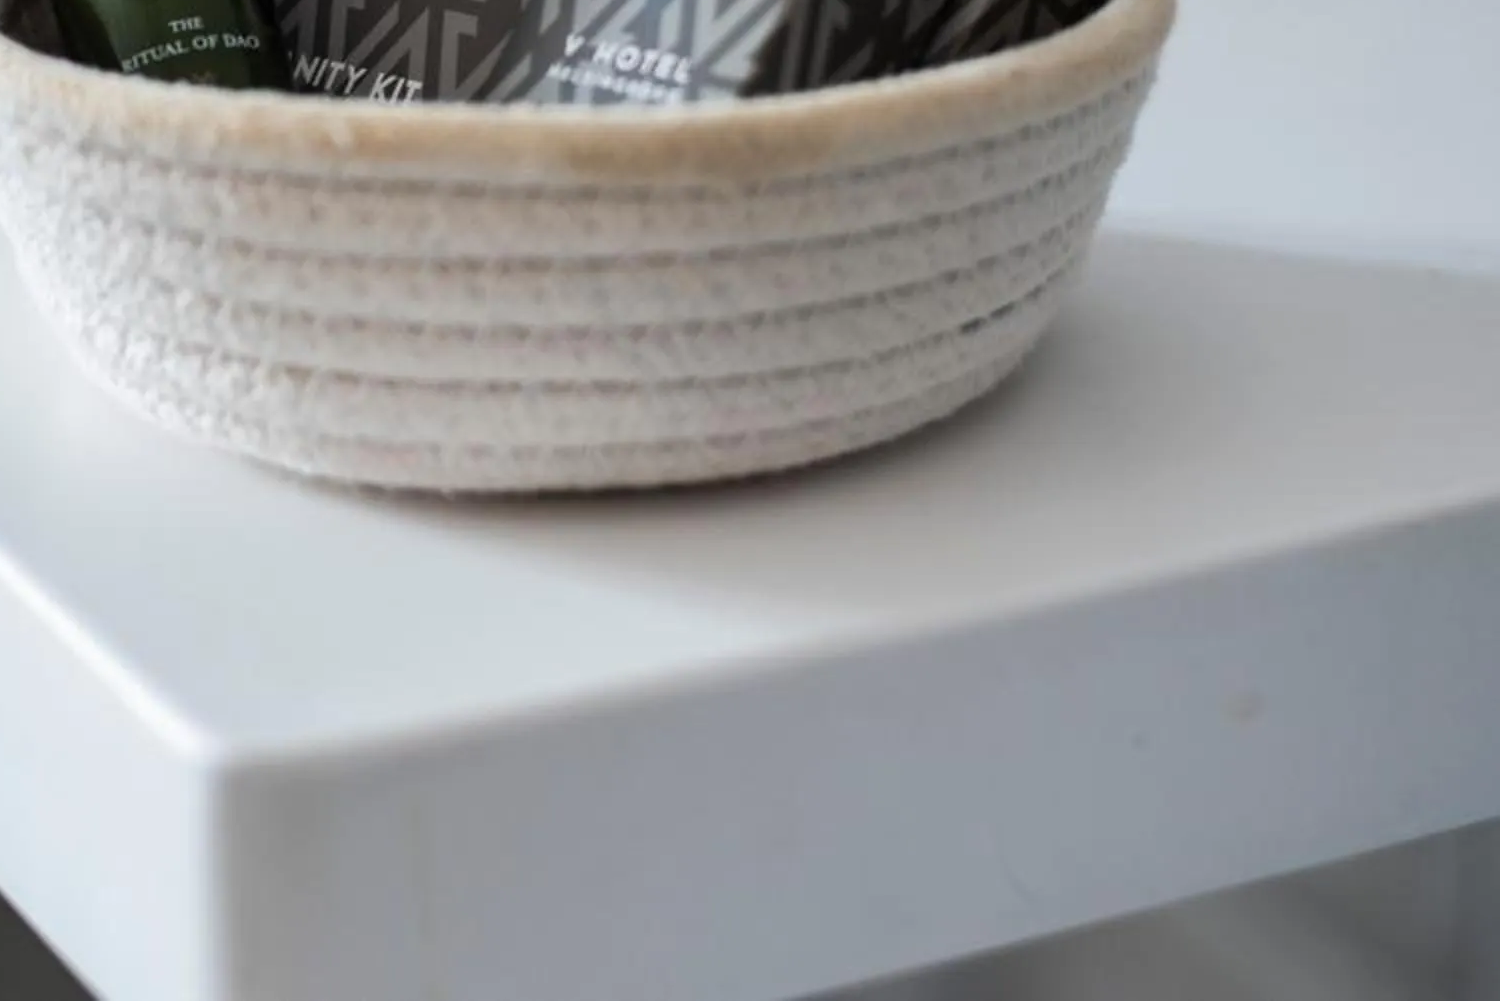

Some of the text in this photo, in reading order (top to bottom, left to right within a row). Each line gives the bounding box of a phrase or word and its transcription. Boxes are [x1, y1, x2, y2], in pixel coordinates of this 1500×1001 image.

[168, 17, 203, 33] THE
[122, 33, 260, 72] RITUAL OF DAO
[564, 33, 586, 57] V
[592, 39, 693, 86] HOTEL
[288, 51, 423, 103] NITY KIT
